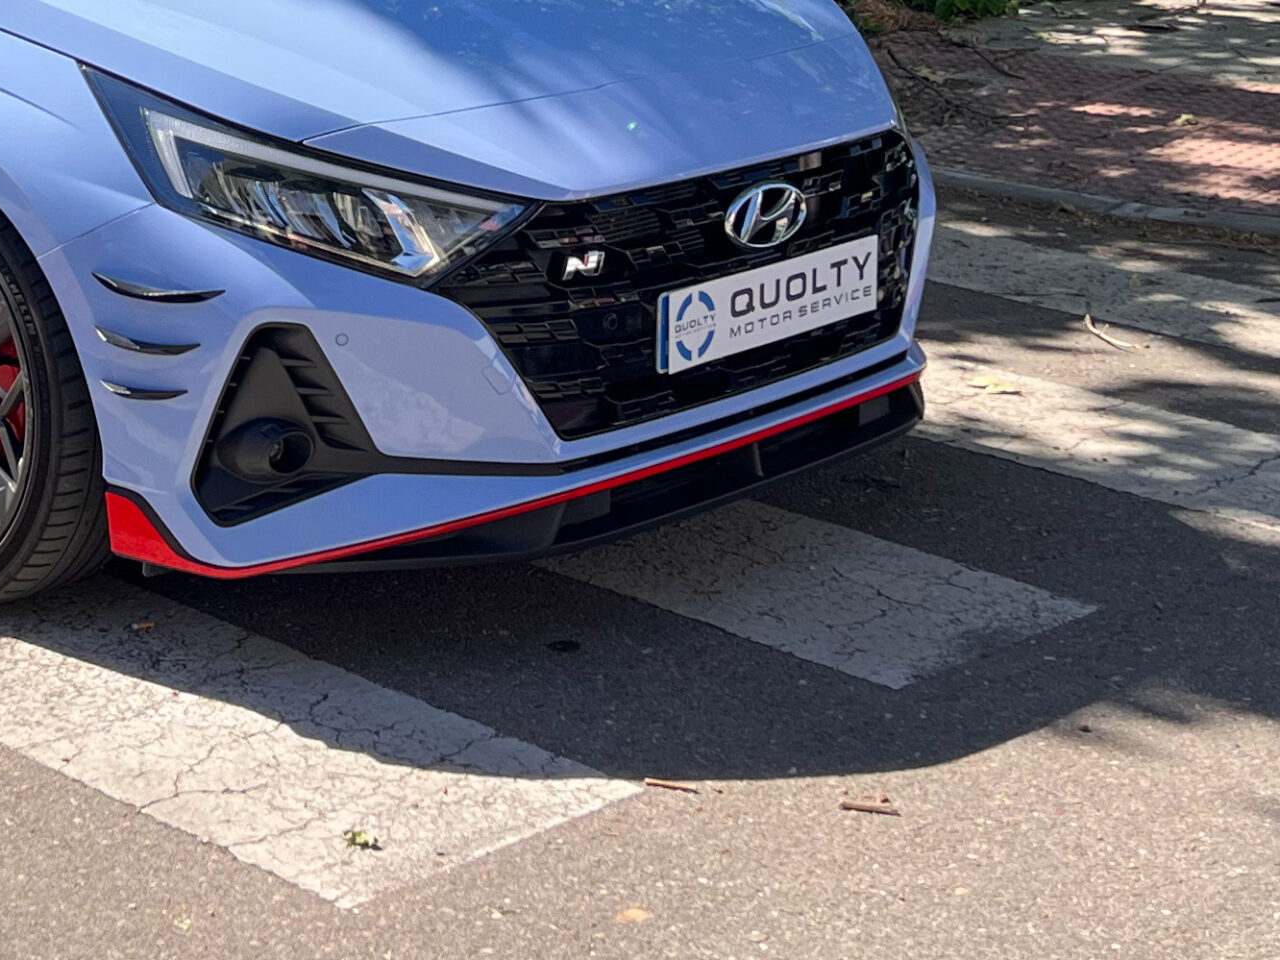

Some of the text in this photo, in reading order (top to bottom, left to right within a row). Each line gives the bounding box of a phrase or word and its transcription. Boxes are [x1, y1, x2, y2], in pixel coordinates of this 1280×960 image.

[729, 310, 793, 338] MOTOR
[798, 285, 873, 316] SERVICE
[730, 252, 872, 318] QUOLTY
[674, 313, 717, 333] QUOLTY
